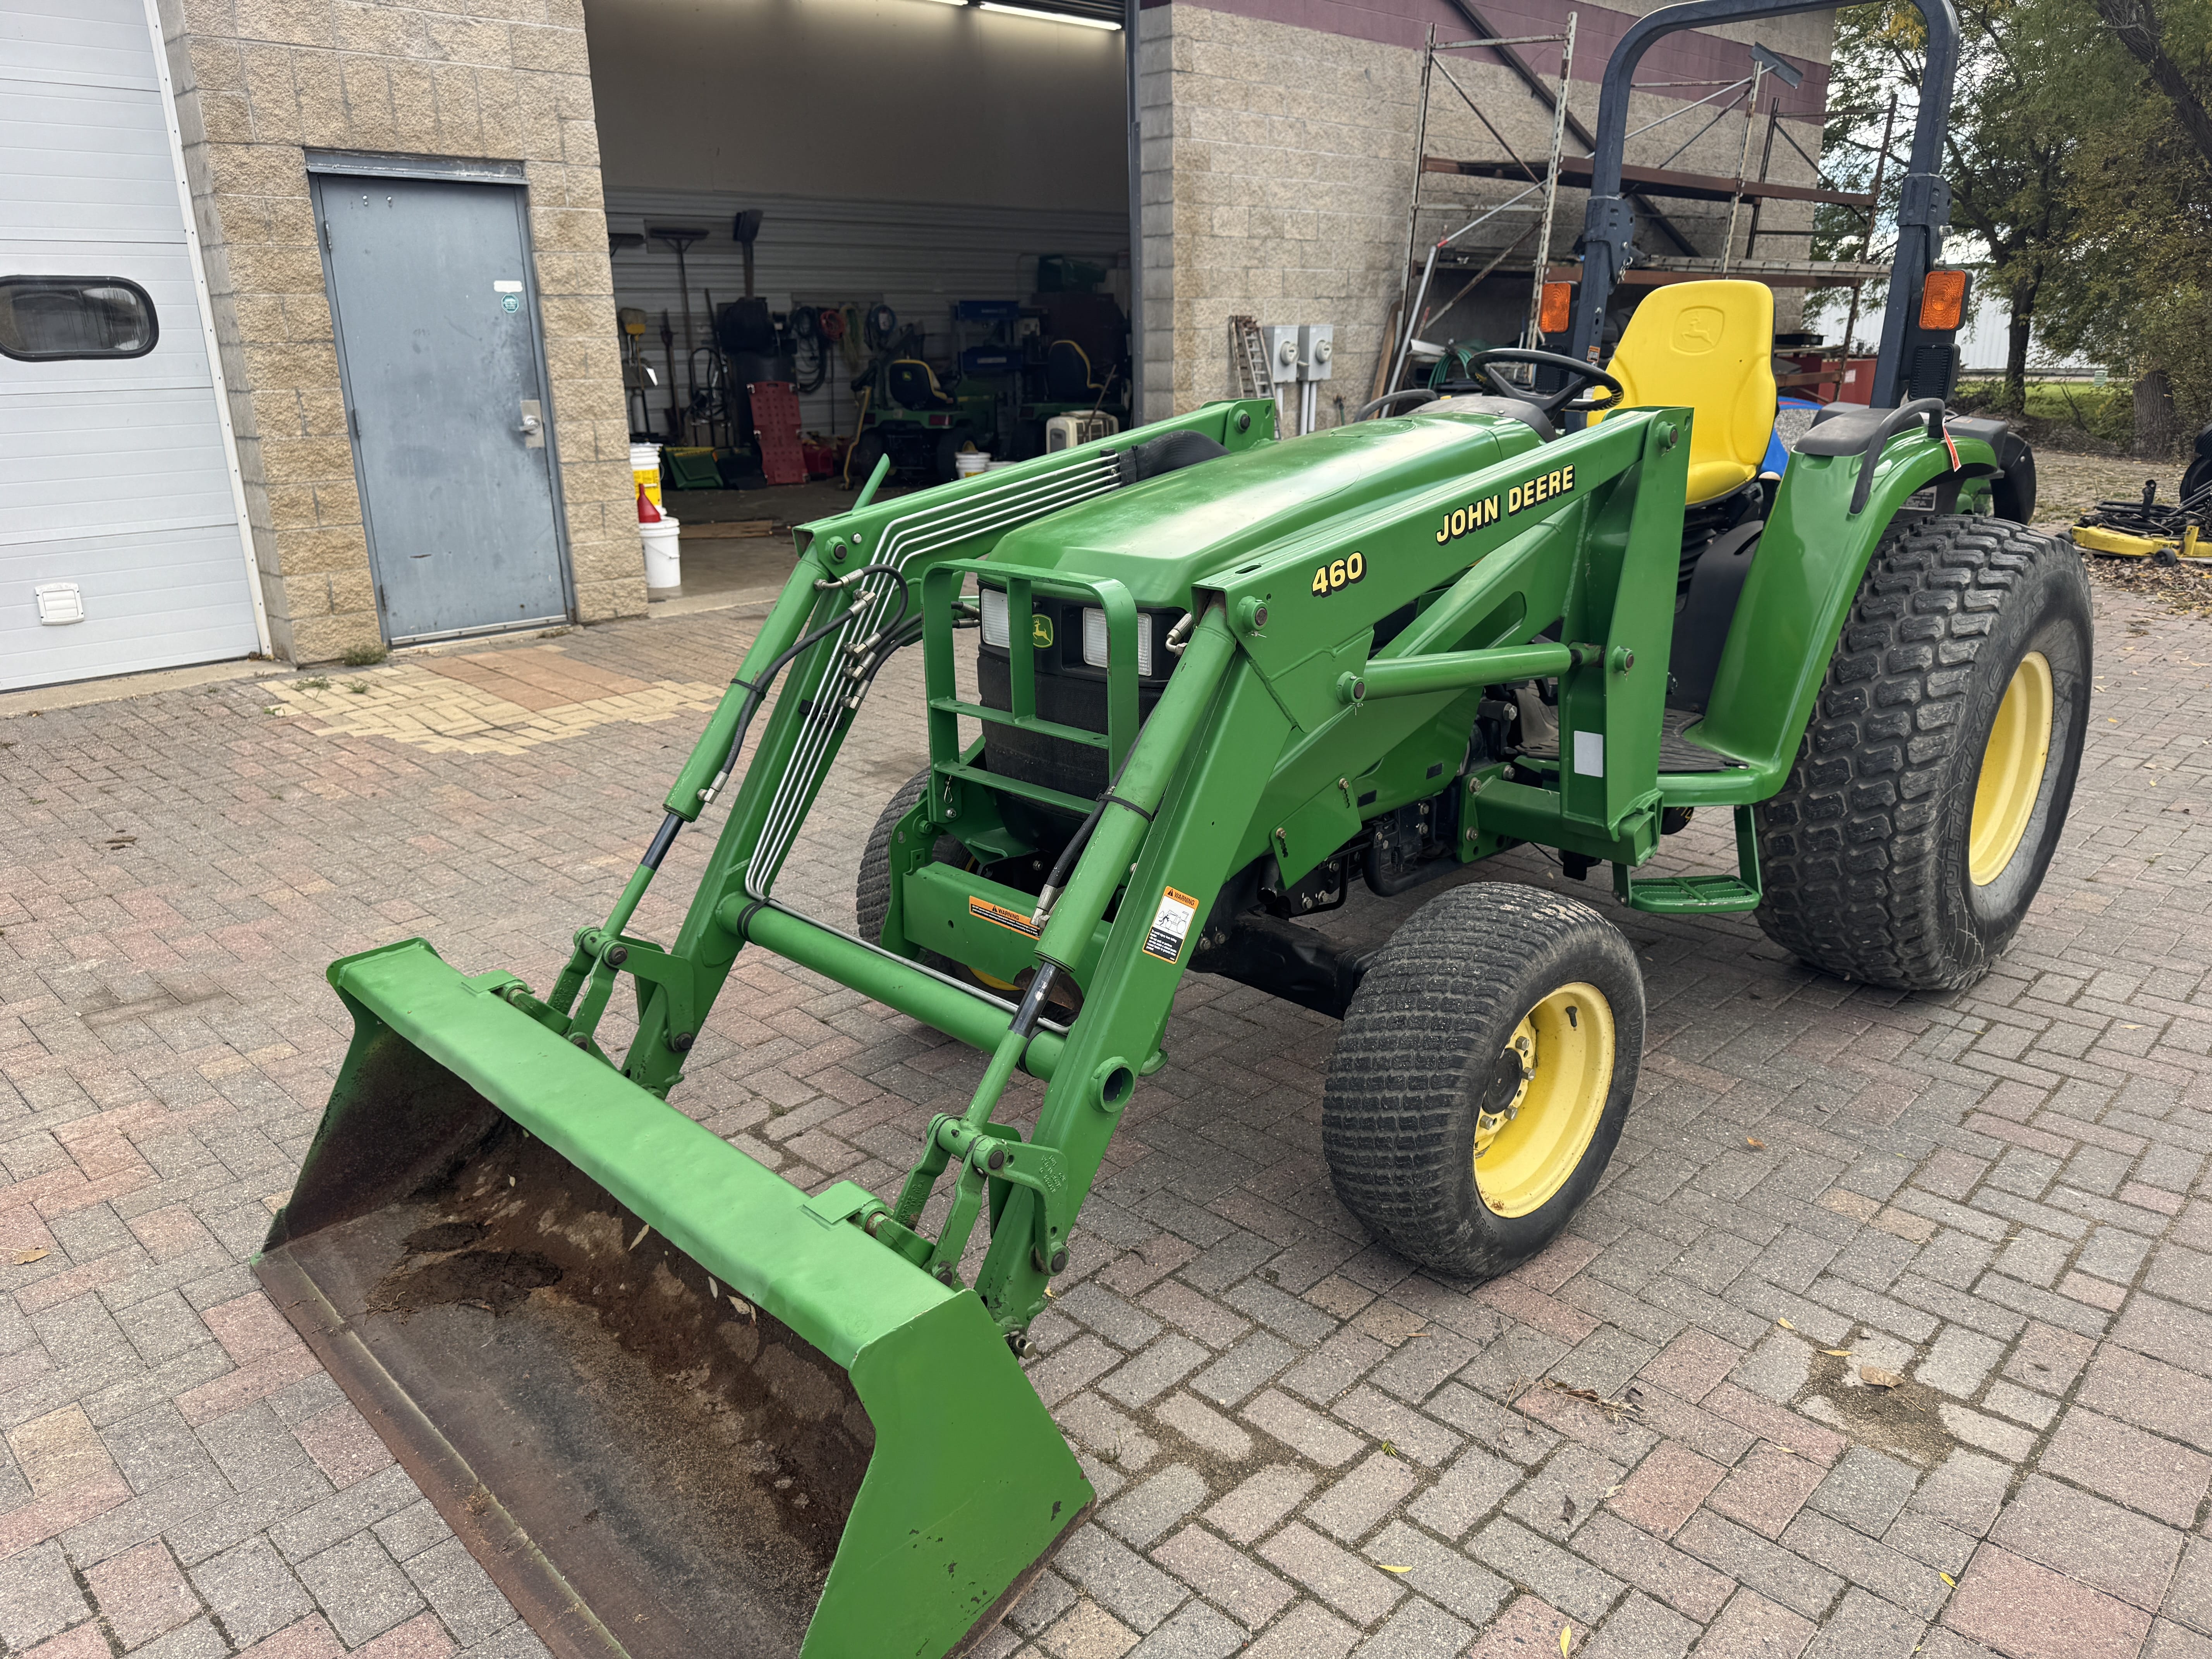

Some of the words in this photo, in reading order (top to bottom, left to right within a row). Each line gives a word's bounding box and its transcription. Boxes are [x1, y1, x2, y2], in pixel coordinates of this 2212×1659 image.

[1436, 495, 1501, 545] JOHN
[1508, 463, 1575, 516] DEERE
[1312, 551, 1366, 597] 460
[1945, 799, 1965, 915] MULTI
[1958, 656, 2005, 782] TRAC
[998, 908, 1019, 921] WARNING
[1175, 892, 1195, 906] WARNING
[1623, 1016, 1641, 1096] TITAN
